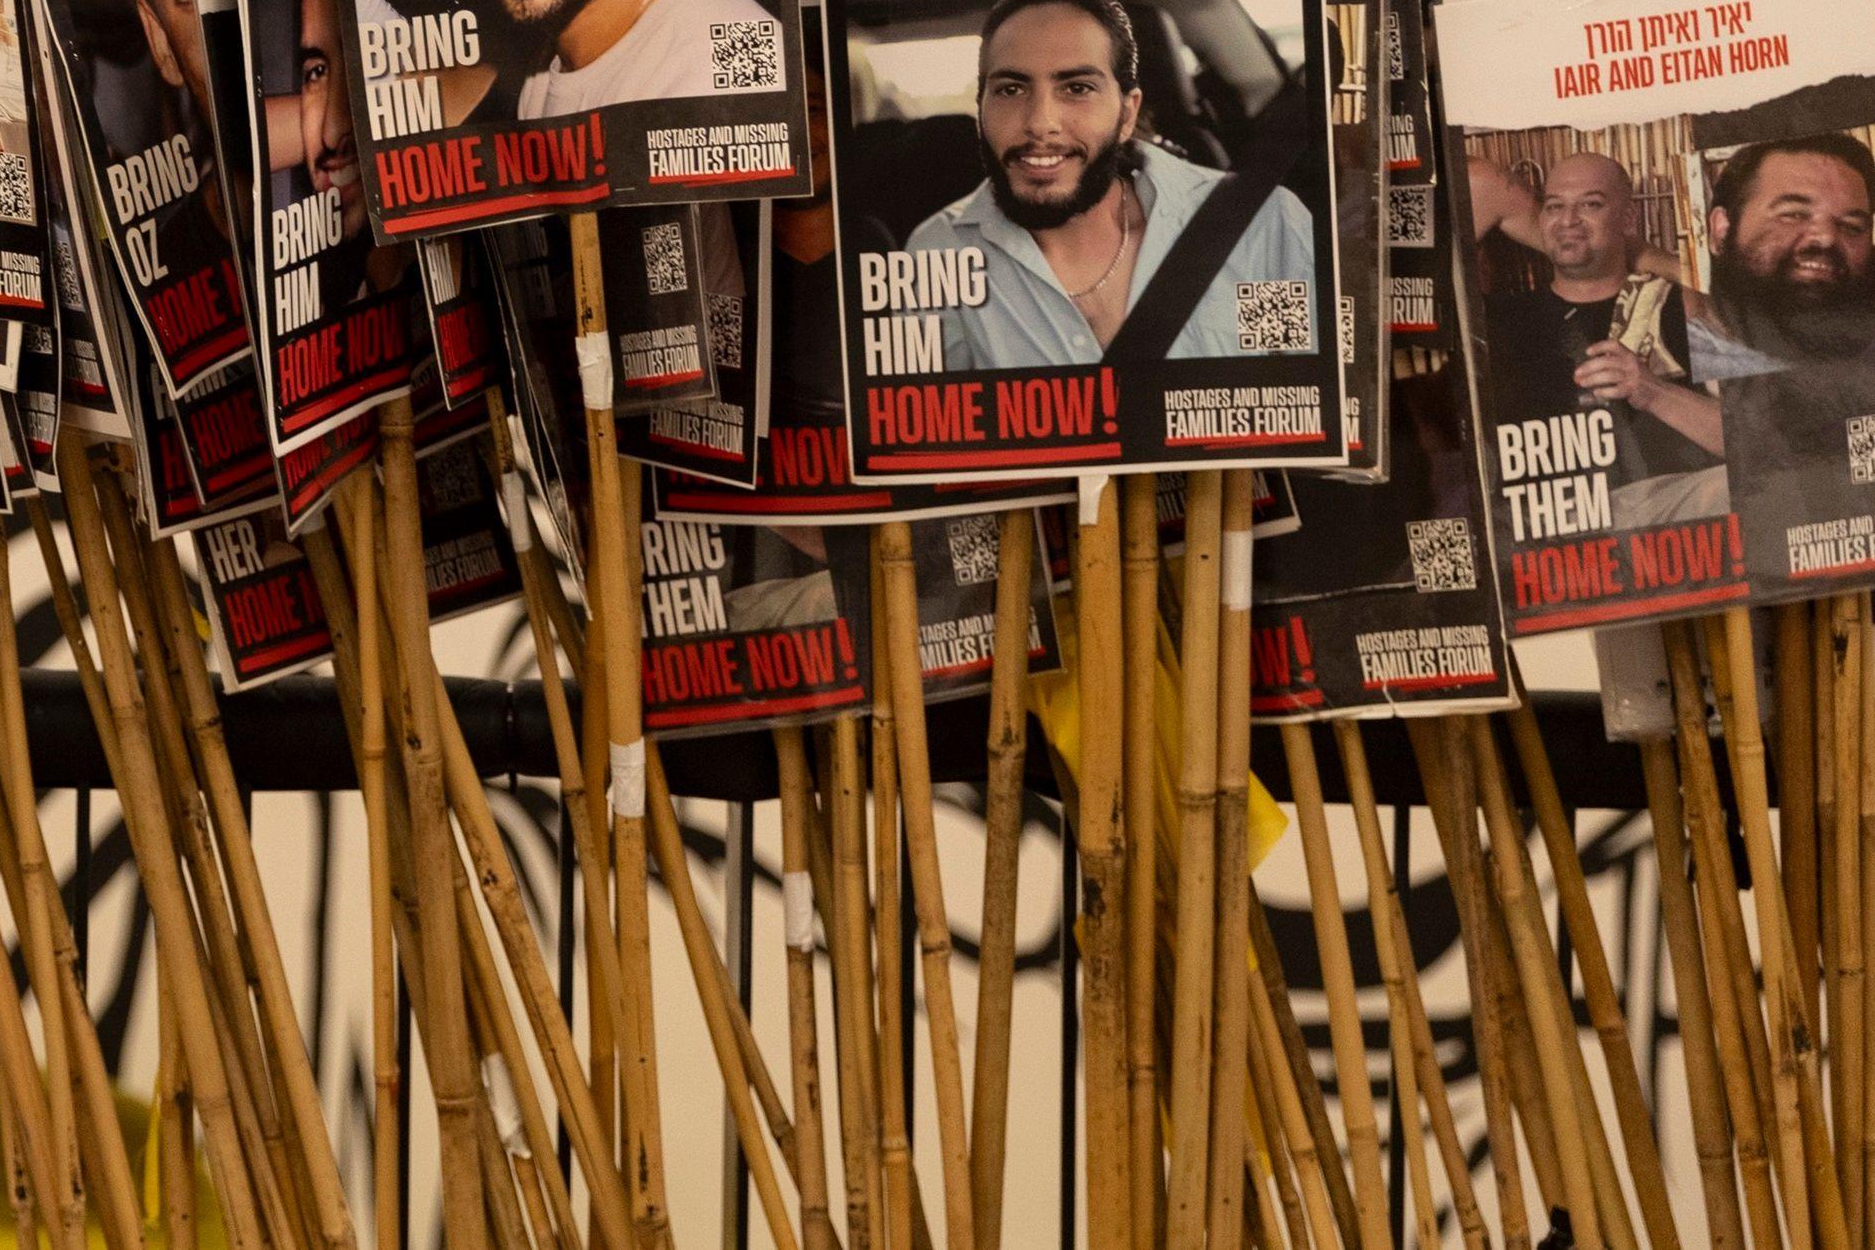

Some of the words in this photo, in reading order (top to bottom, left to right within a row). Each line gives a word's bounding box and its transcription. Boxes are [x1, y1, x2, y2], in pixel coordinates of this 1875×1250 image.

[357, 9, 482, 81] BRING
[1583, 17, 1634, 60] הורן
[1639, 9, 1701, 54] ואיתן
[1704, 0, 1752, 40] יאיר
[1553, 62, 1603, 100] IAIR
[1607, 54, 1655, 95] AND
[1661, 44, 1724, 87] EITAN
[1728, 34, 1791, 76] HORN
[366, 75, 444, 141] HIM
[646, 127, 707, 150] HOSTAGES
[708, 126, 733, 147] AND
[733, 122, 789, 145] MISSING
[106, 132, 201, 225] BRING
[374, 135, 488, 210] HOME
[494, 111, 607, 188] NOW!
[648, 146, 727, 178] FAMILIES
[727, 142, 792, 175] FORUM
[124, 218, 169, 288] OZ
[271, 186, 343, 270] BRING
[0, 250, 40, 274] MISSING
[859, 246, 989, 312] BRING
[147, 265, 226, 357] HOME
[275, 261, 323, 336] HIM
[278, 320, 344, 408] HOME
[665, 343, 702, 376] FORUM
[863, 314, 945, 377] HIM
[866, 382, 985, 445] HOME
[998, 365, 1120, 441] NOW!
[1164, 388, 1232, 411] HOSTAGES
[1233, 387, 1260, 409] AND
[1261, 384, 1320, 408] MISSING
[1166, 409, 1250, 440] FAMILIES
[1253, 406, 1322, 437] FORUM
[649, 408, 702, 447] FAMILIES
[702, 416, 744, 455] FORUM
[1496, 408, 1618, 484] BRING
[1502, 471, 1613, 543] THEM
[1786, 518, 1848, 547] HOSTAGES
[1848, 515, 1875, 537] AND
[205, 519, 264, 585] HER
[1511, 536, 1623, 611] HOME
[1628, 512, 1747, 597] NOW!
[1788, 533, 1868, 575] FAMILIES
[225, 571, 308, 649] HOME
[958, 615, 983, 636] AND
[1356, 632, 1418, 655] HOSTAGES
[1418, 629, 1442, 650] AND
[1442, 625, 1490, 648] MISSING
[642, 638, 753, 704] HOME
[752, 617, 858, 691] NOW!
[1360, 650, 1440, 683] FAMILIES
[1440, 644, 1494, 679] FORUM
